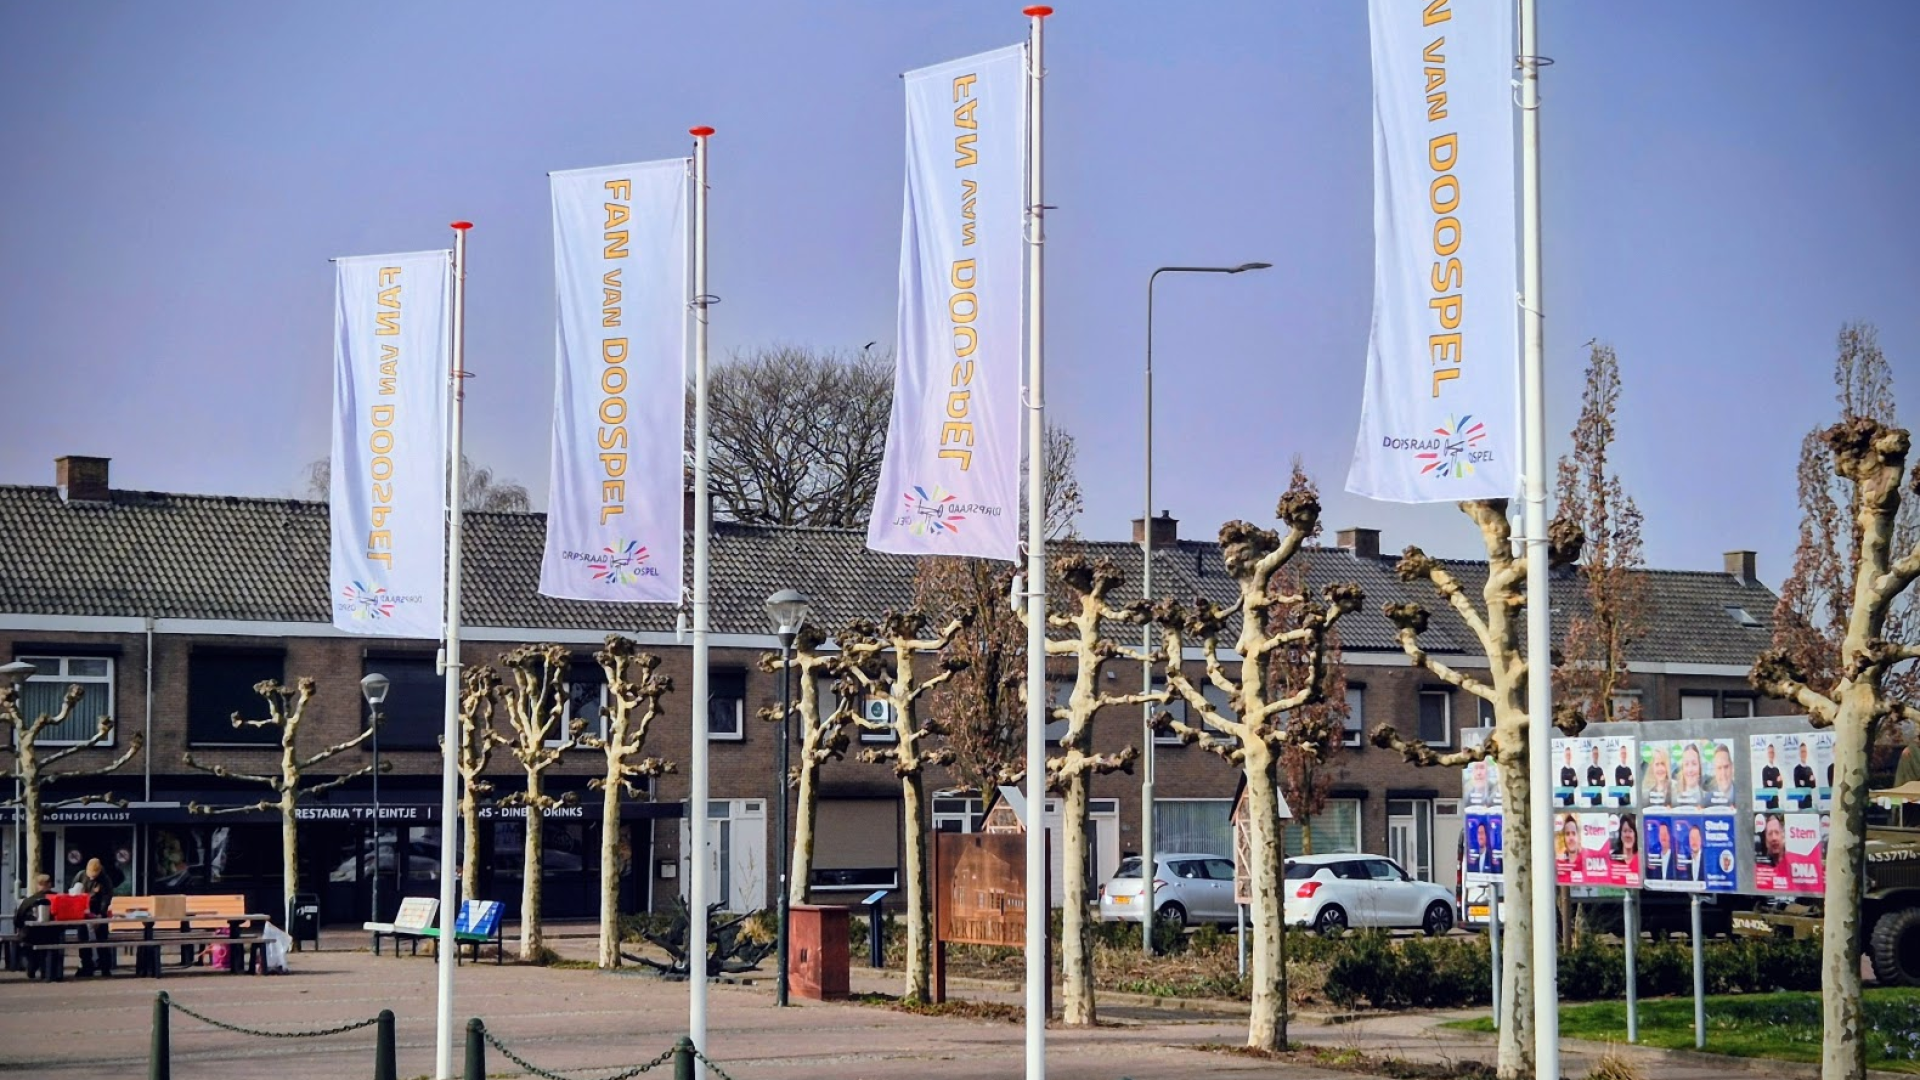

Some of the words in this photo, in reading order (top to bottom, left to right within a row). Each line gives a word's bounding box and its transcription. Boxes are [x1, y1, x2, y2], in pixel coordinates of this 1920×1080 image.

[1423, 36, 1448, 122] VAN
[604, 179, 632, 260] FAN
[1428, 132, 1463, 398] DOOSPEL
[602, 268, 622, 328] VAN
[597, 337, 629, 526] DOOSPEL
[543, 807, 583, 818] DRINKS
[1583, 824, 1606, 836] Stem
[1789, 826, 1817, 839] Stem
[1585, 857, 1608, 871] DNA
[1790, 862, 1819, 878] DNA
